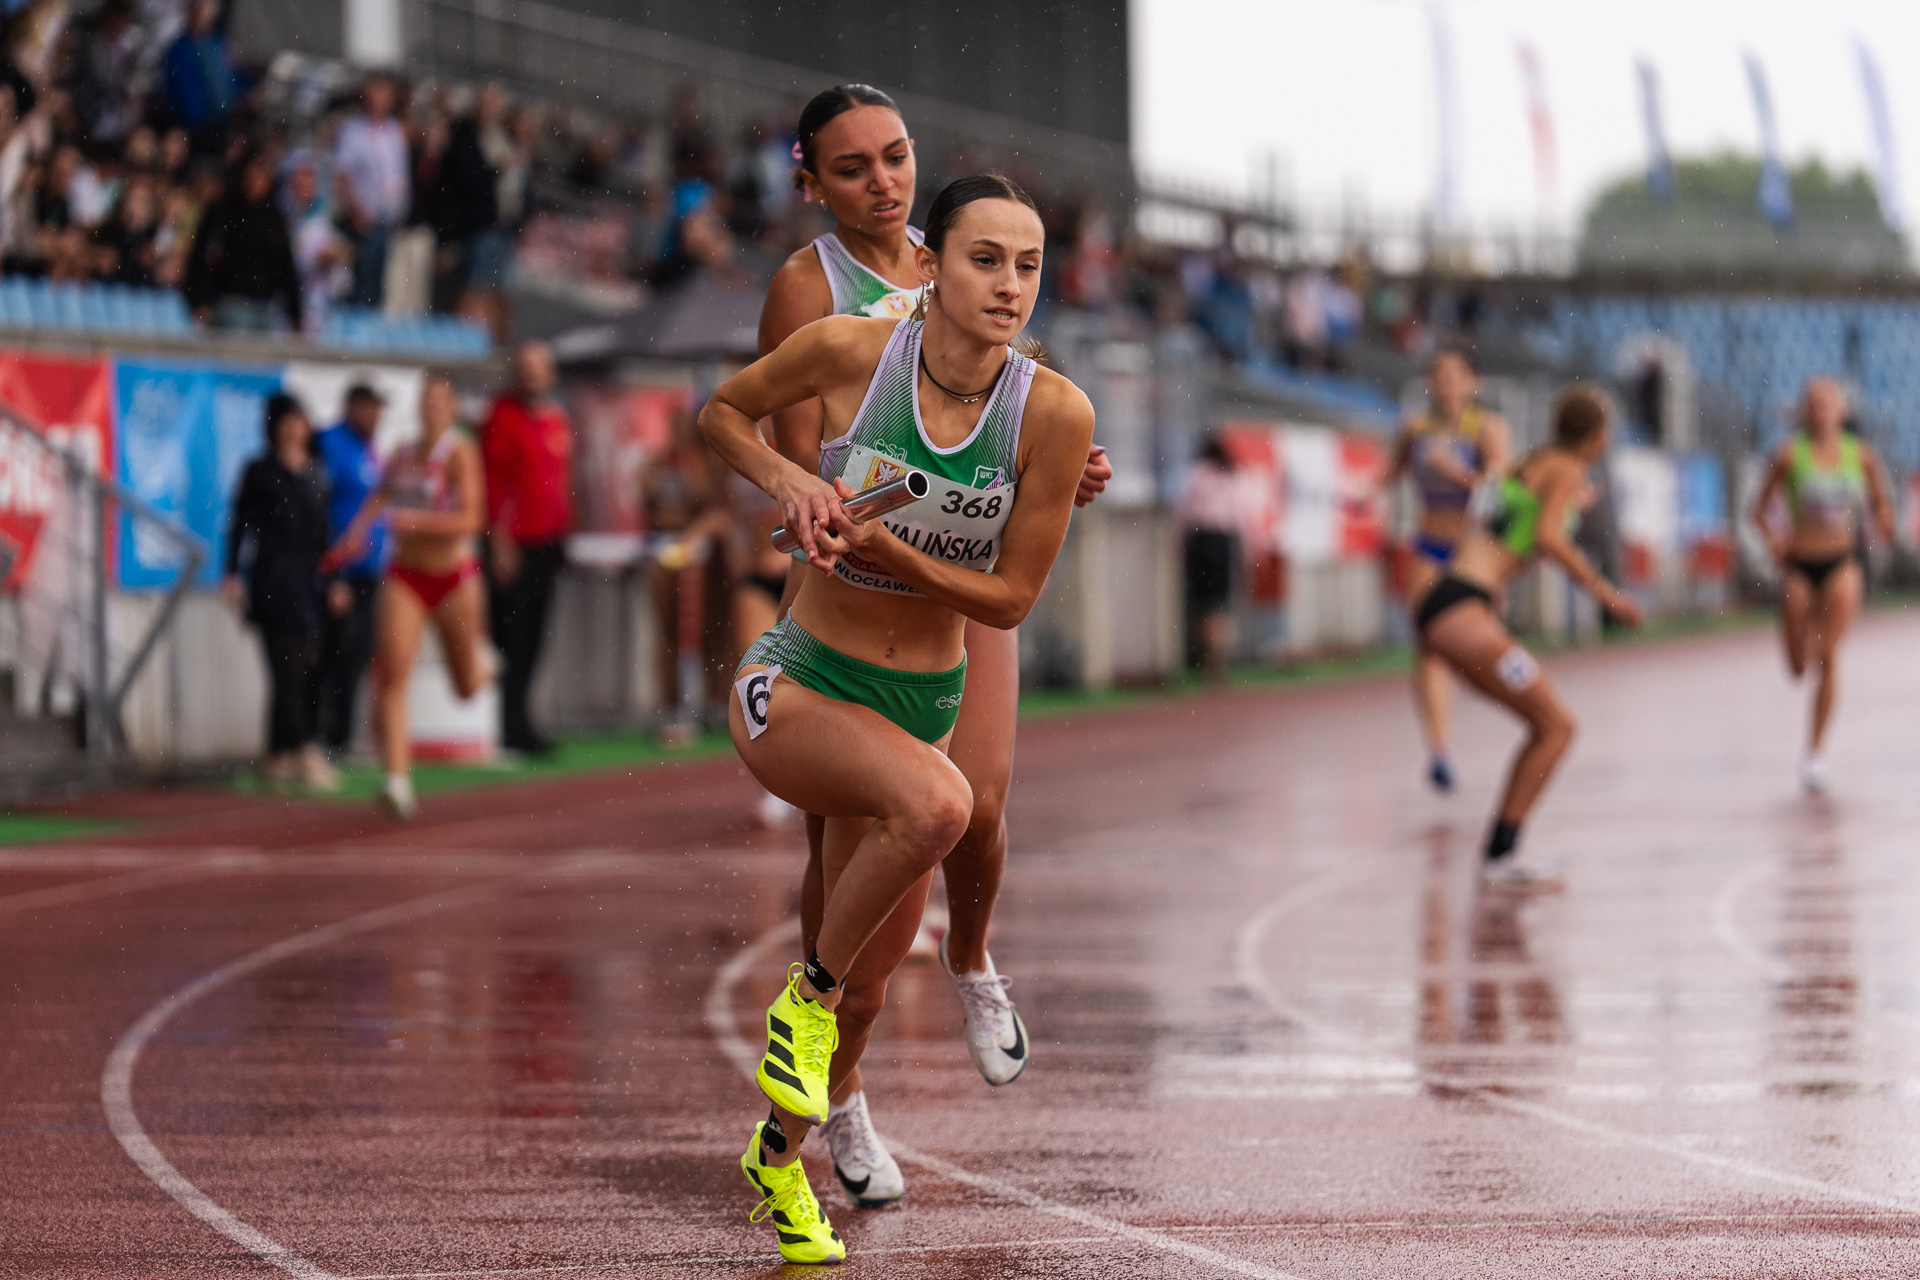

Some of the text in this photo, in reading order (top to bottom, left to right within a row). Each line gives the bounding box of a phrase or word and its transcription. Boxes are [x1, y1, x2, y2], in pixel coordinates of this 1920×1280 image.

[980, 471, 993, 479] WKS
[941, 490, 1002, 519] 368
[834, 560, 919, 593] WŁOCŁAWE
[747, 676, 770, 726] 6
